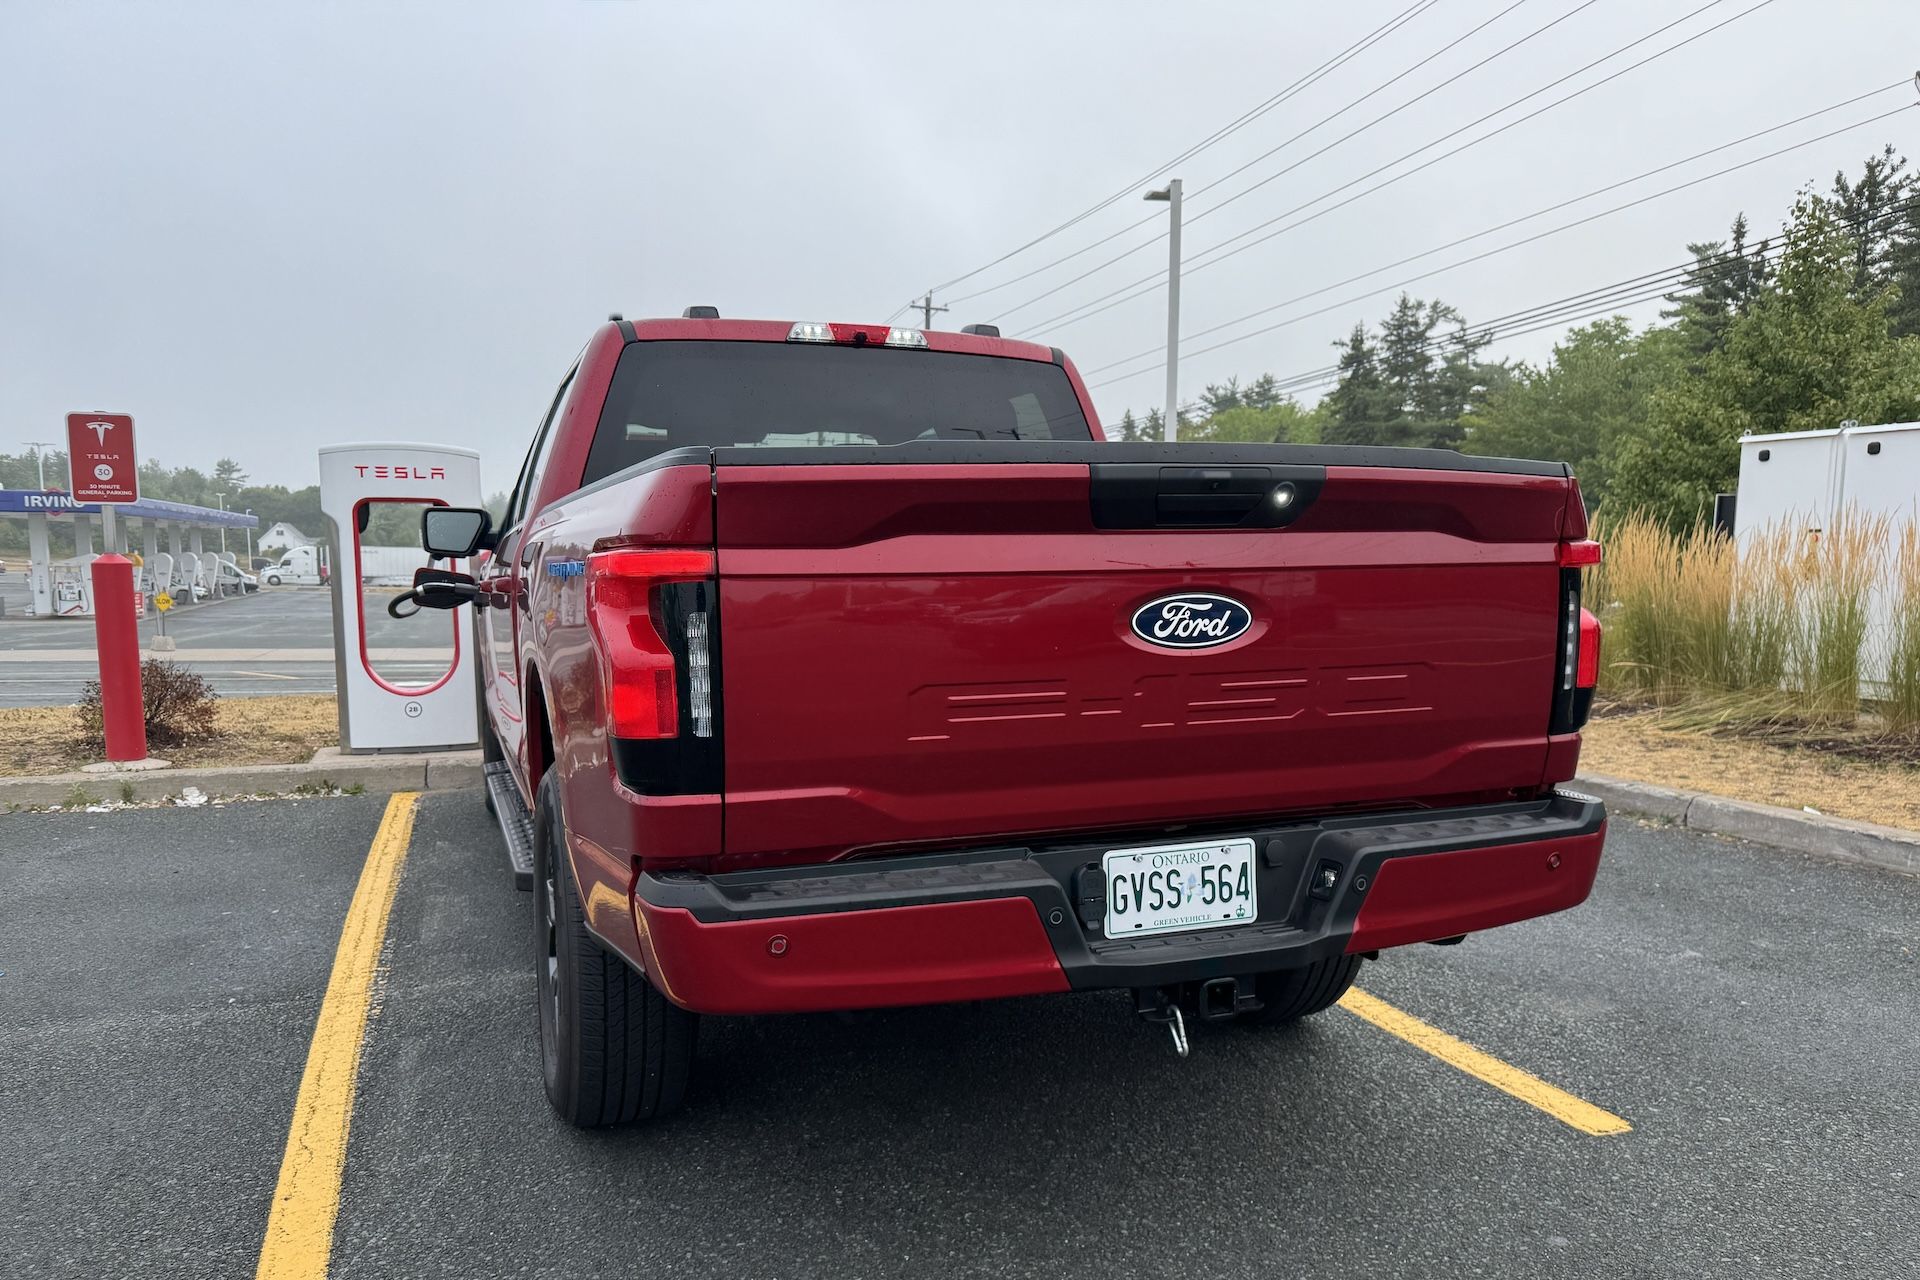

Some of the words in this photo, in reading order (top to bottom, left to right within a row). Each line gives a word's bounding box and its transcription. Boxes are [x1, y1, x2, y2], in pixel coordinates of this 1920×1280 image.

[97, 468, 110, 476] 30
[354, 465, 445, 480] TESLA
[24, 495, 85, 508] IRVIN
[1153, 601, 1232, 638] Ford
[1152, 851, 1210, 869] ONTARIO
[1112, 868, 1182, 915] GVSS
[1200, 861, 1250, 905] 564
[1153, 917, 1180, 926] GREEN
[1180, 913, 1212, 923] VEHICLE
